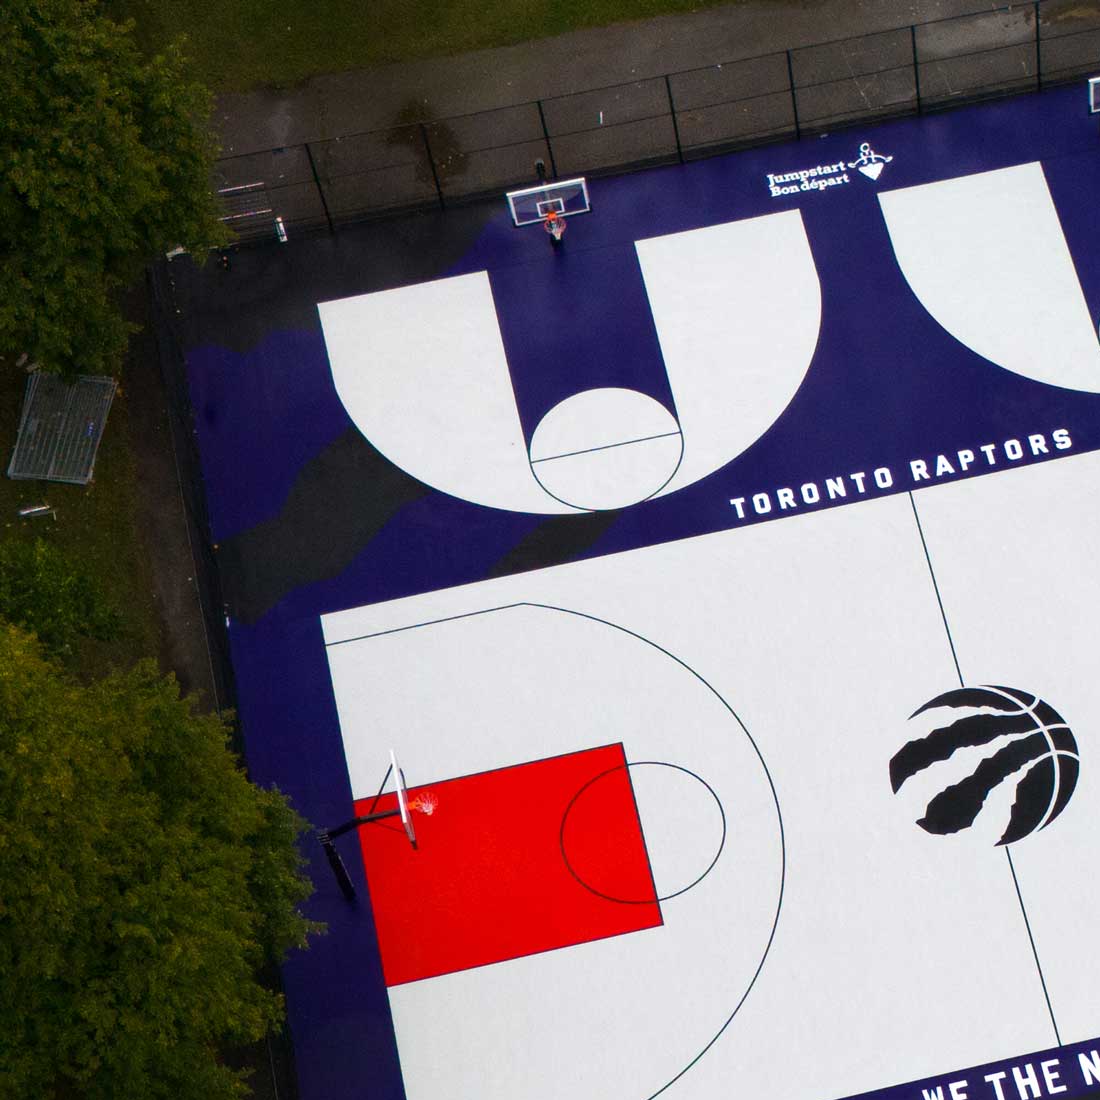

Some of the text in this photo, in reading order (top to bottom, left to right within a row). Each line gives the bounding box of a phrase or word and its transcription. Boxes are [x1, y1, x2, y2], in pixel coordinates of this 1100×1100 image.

[767, 161, 847, 187] Jumpstart
[770, 173, 850, 197] Bon départ
[730, 428, 1073, 519] TORONTO RAPTORS
